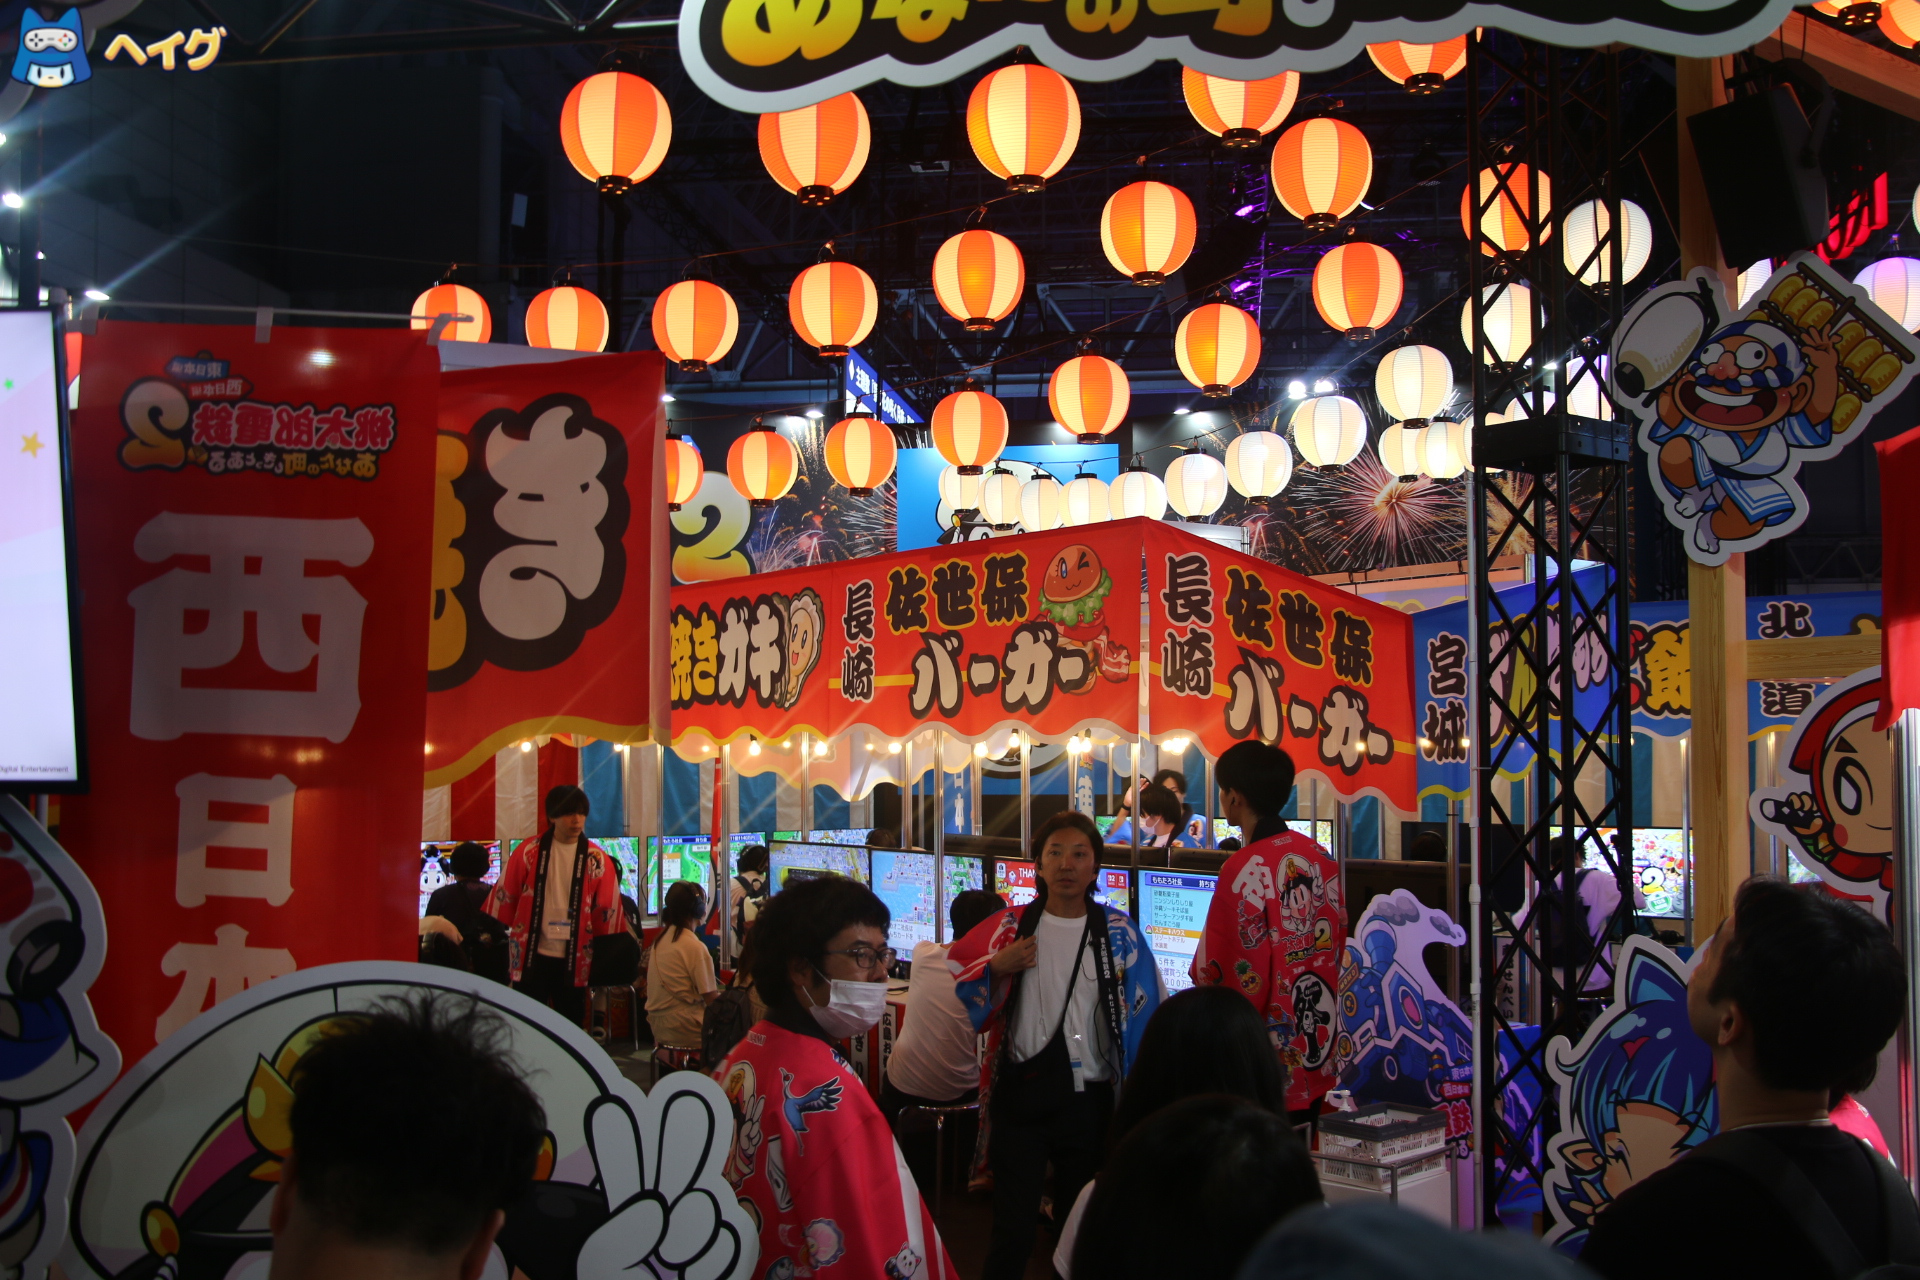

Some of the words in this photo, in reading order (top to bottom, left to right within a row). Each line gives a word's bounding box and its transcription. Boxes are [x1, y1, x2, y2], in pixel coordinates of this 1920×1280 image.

[670, 471, 751, 584] 2
[841, 579, 875, 703] 長崎
[884, 550, 1029, 634] 佐世保
[1162, 552, 1213, 698] 長崎
[1223, 564, 1373, 687] 佐世保
[671, 597, 782, 706] 焼きガキ
[909, 621, 1090, 718] バーガー
[1425, 631, 1469, 764] 宮城
[1758, 601, 1814, 717] 北道
[1225, 646, 1393, 776] バーガー
[1152, 876, 1183, 886] ももたろ社長
